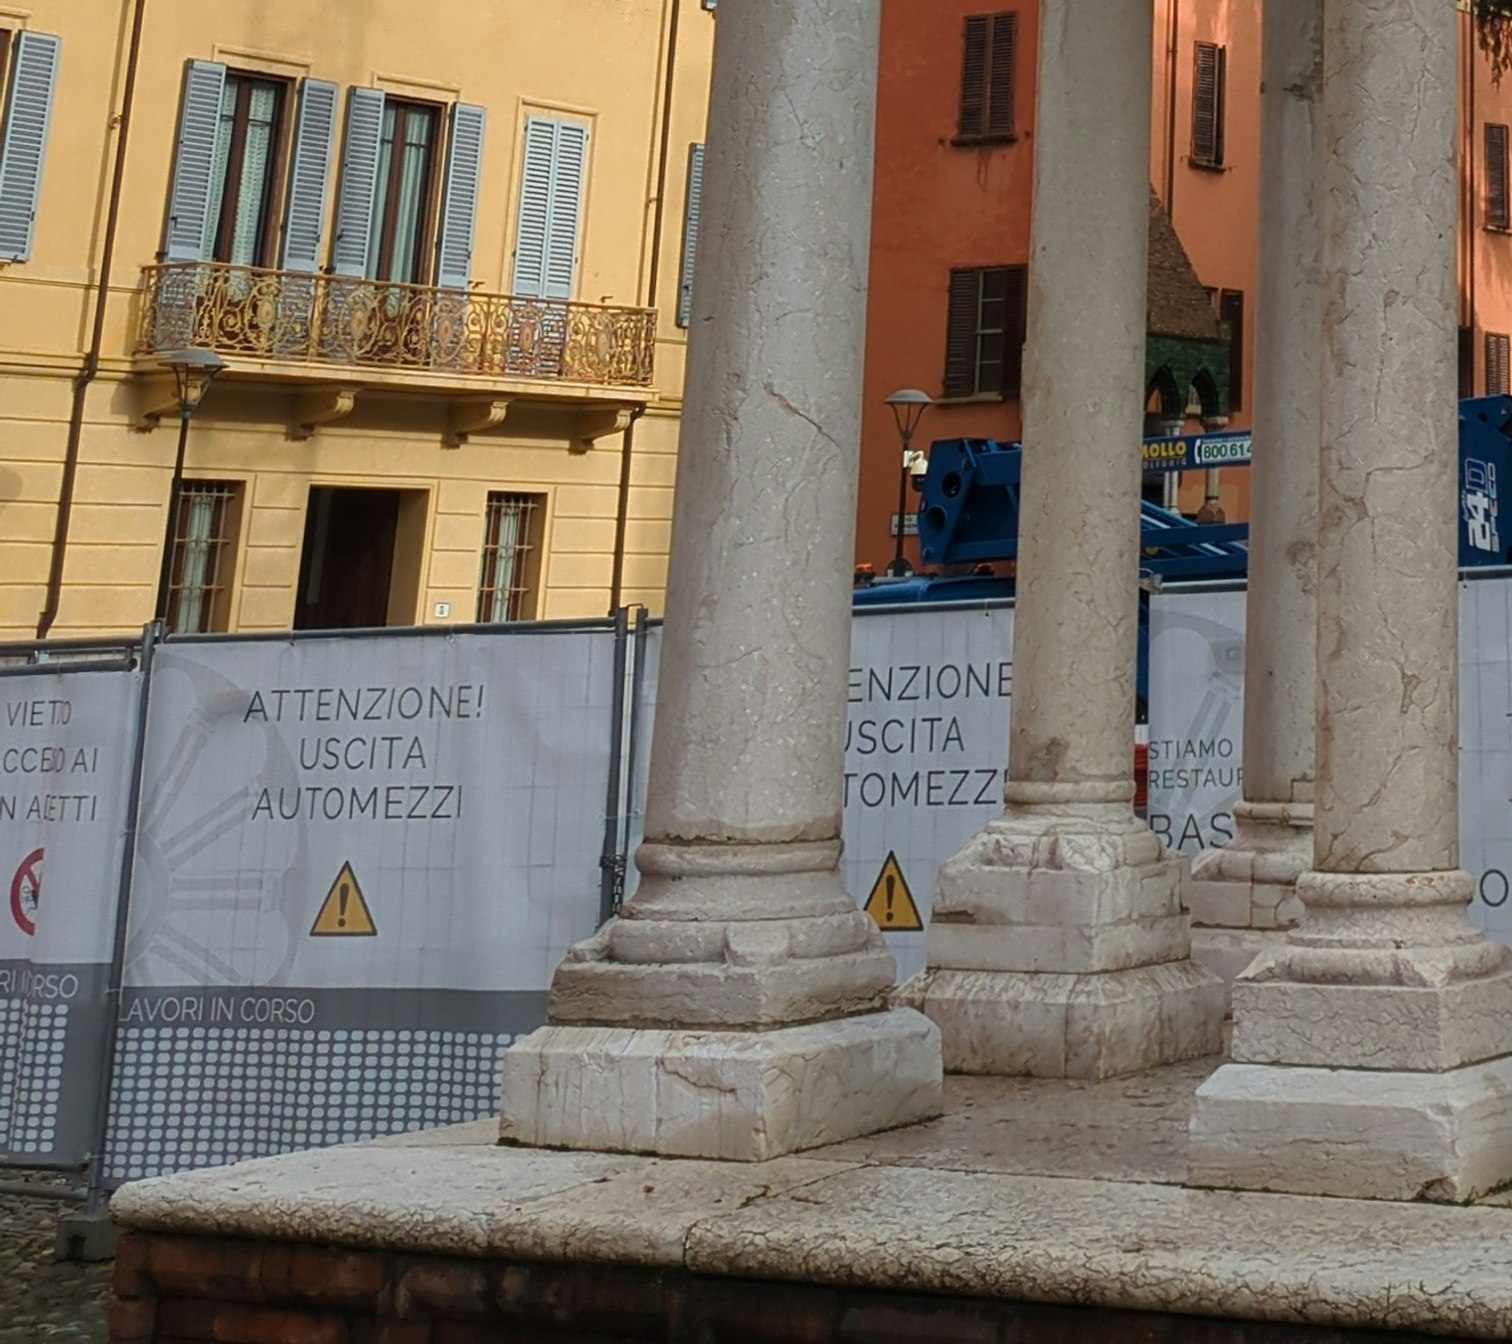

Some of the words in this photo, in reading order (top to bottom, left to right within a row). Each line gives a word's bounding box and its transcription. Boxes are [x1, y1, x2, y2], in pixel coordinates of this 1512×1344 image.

[243, 684, 484, 723] ATTENZIONE!
[299, 736, 427, 770] USCITA
[1149, 738, 1233, 761] STIAMO
[251, 785, 462, 821] AUTOMEZZI
[118, 996, 204, 1022] LAVORI
[210, 996, 235, 1022] IN
[240, 997, 316, 1024] CORSO
